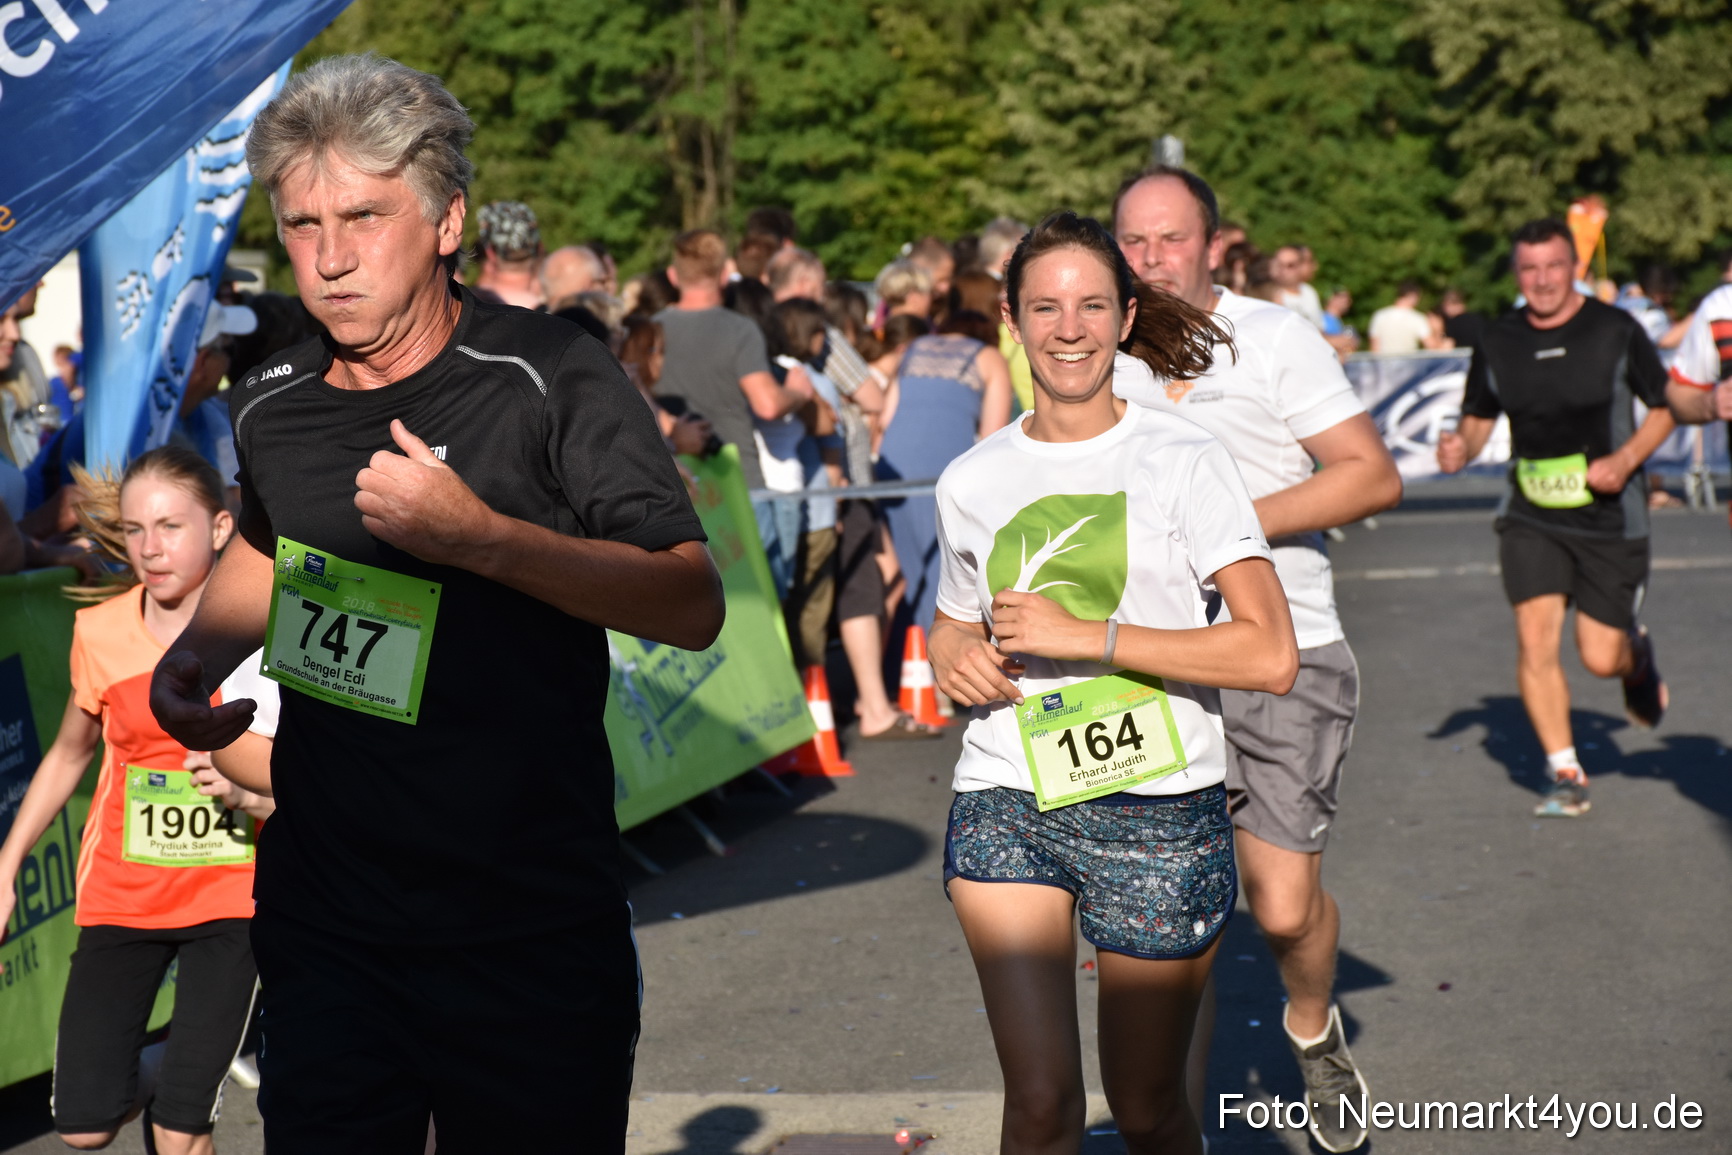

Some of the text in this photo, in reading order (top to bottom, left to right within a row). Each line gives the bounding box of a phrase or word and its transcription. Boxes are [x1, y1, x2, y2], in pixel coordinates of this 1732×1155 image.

[260, 364, 293, 381] JAKO
[293, 566, 339, 592] firmenlauf
[342, 596, 375, 613] 2018
[299, 599, 389, 669] 747
[276, 660, 319, 684] Grundschule
[320, 677, 330, 688] an
[331, 681, 345, 693] der
[347, 684, 397, 706] Bräugasse
[303, 655, 365, 686] Dengel Edi
[1036, 701, 1083, 722] firmenlauf
[1091, 701, 1118, 716] 2018
[1057, 712, 1144, 768] 164
[1069, 764, 1108, 782] Erhard
[1111, 753, 1147, 771] Judith
[1085, 774, 1123, 788] Bionorica
[1124, 768, 1136, 778] SE
[140, 804, 238, 839] 1904
[150, 840, 223, 854] Prydiuk Sarina
[159, 850, 212, 858] Stadt Neumarkt
[0, 935, 39, 991] arkt
